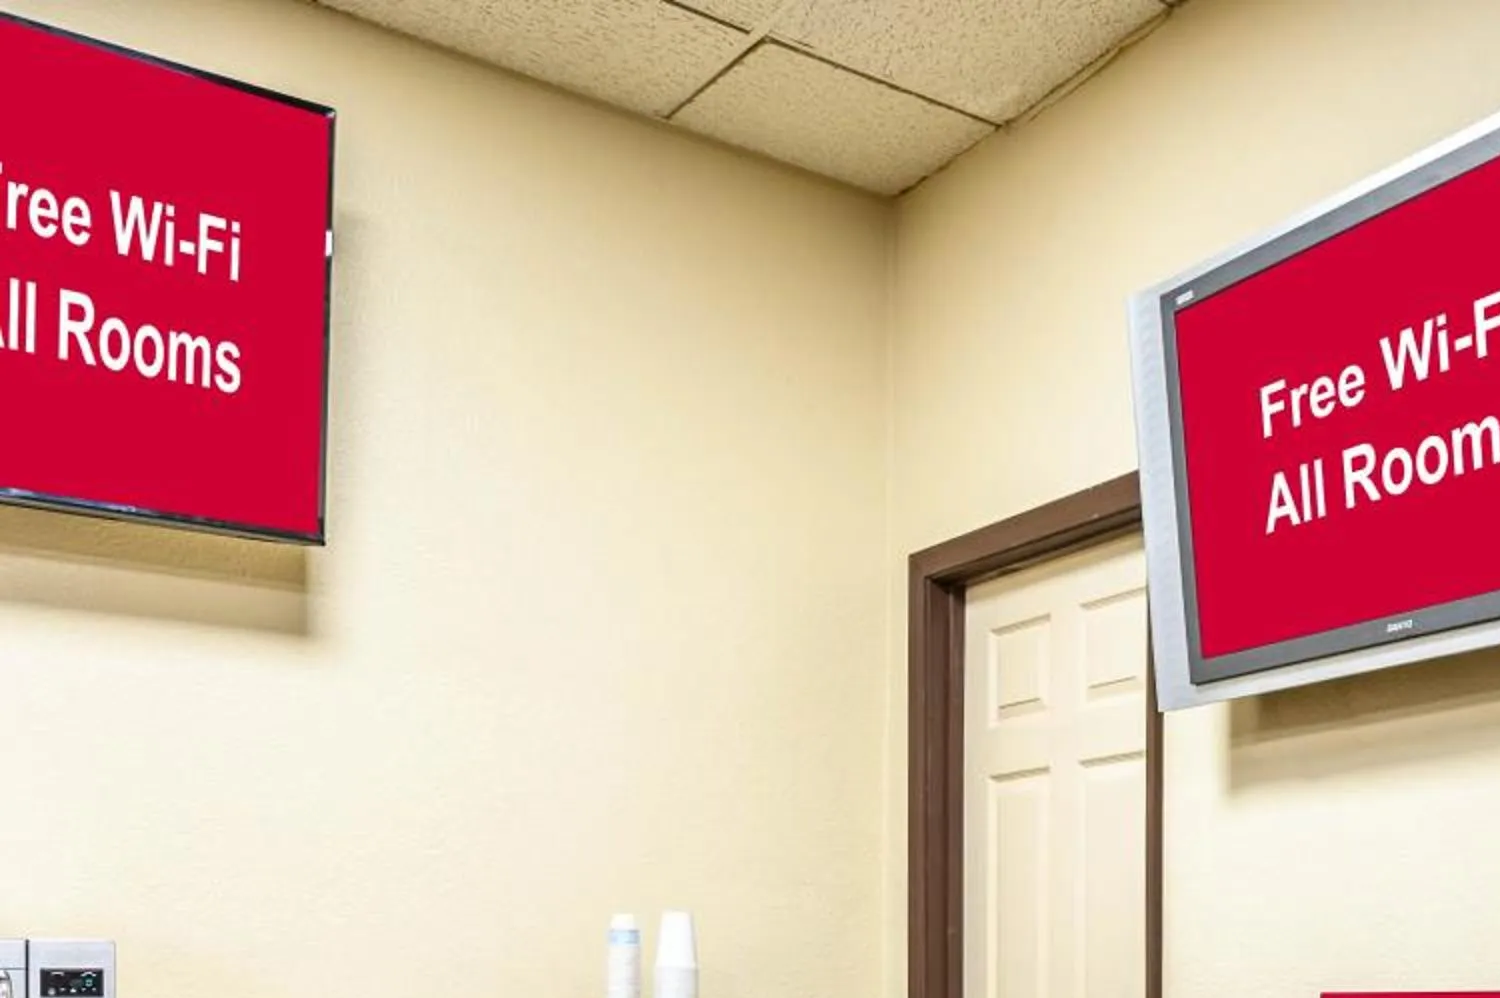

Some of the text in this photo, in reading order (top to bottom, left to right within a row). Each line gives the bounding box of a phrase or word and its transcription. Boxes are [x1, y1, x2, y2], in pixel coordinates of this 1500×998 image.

[0, 162, 241, 282] ree Wi-Fi
[0, 277, 241, 393] ll Rooms
[1260, 364, 1366, 439] Free
[1266, 458, 1326, 534] All
